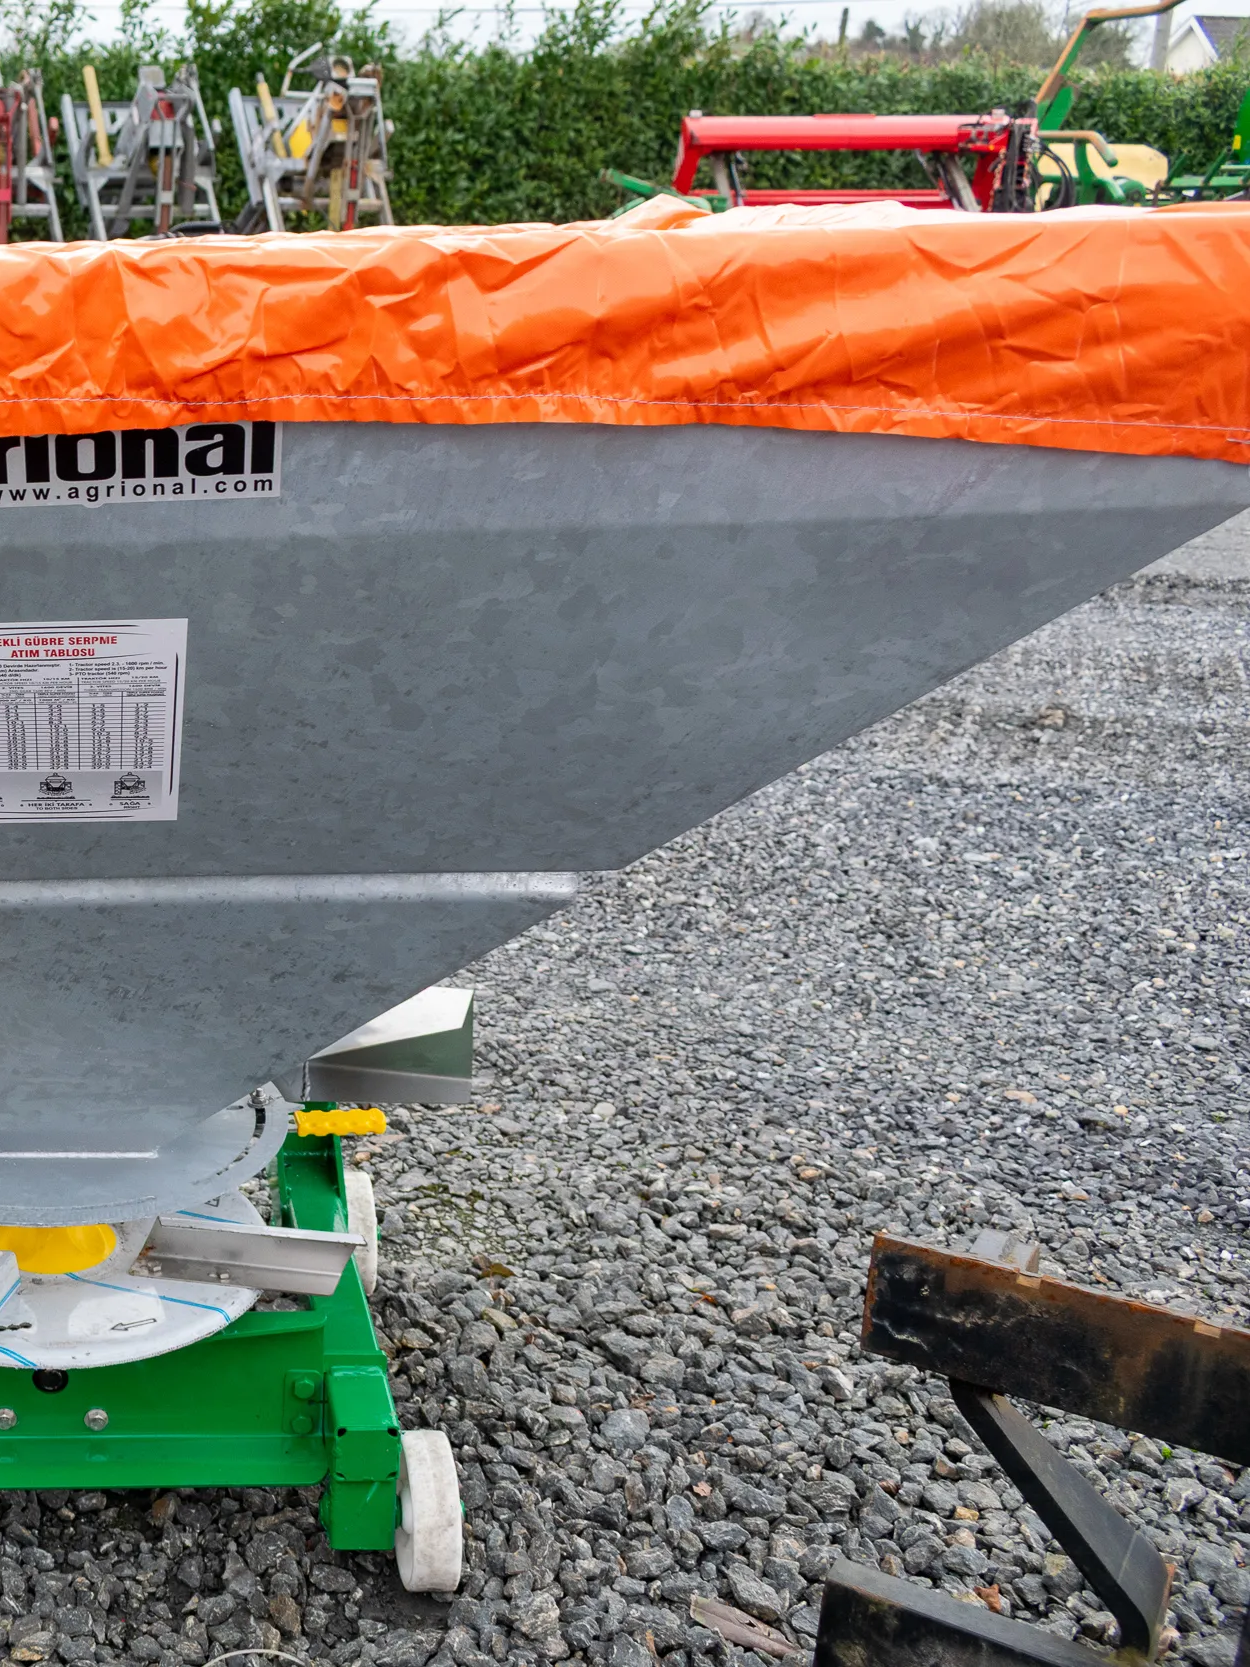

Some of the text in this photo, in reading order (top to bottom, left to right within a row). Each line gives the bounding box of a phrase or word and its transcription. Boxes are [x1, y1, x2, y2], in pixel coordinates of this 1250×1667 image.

[25, 636, 64, 646] GÜBRE
[68, 636, 118, 646] SERPME
[11, 648, 95, 658] ATIM TABLOSU
